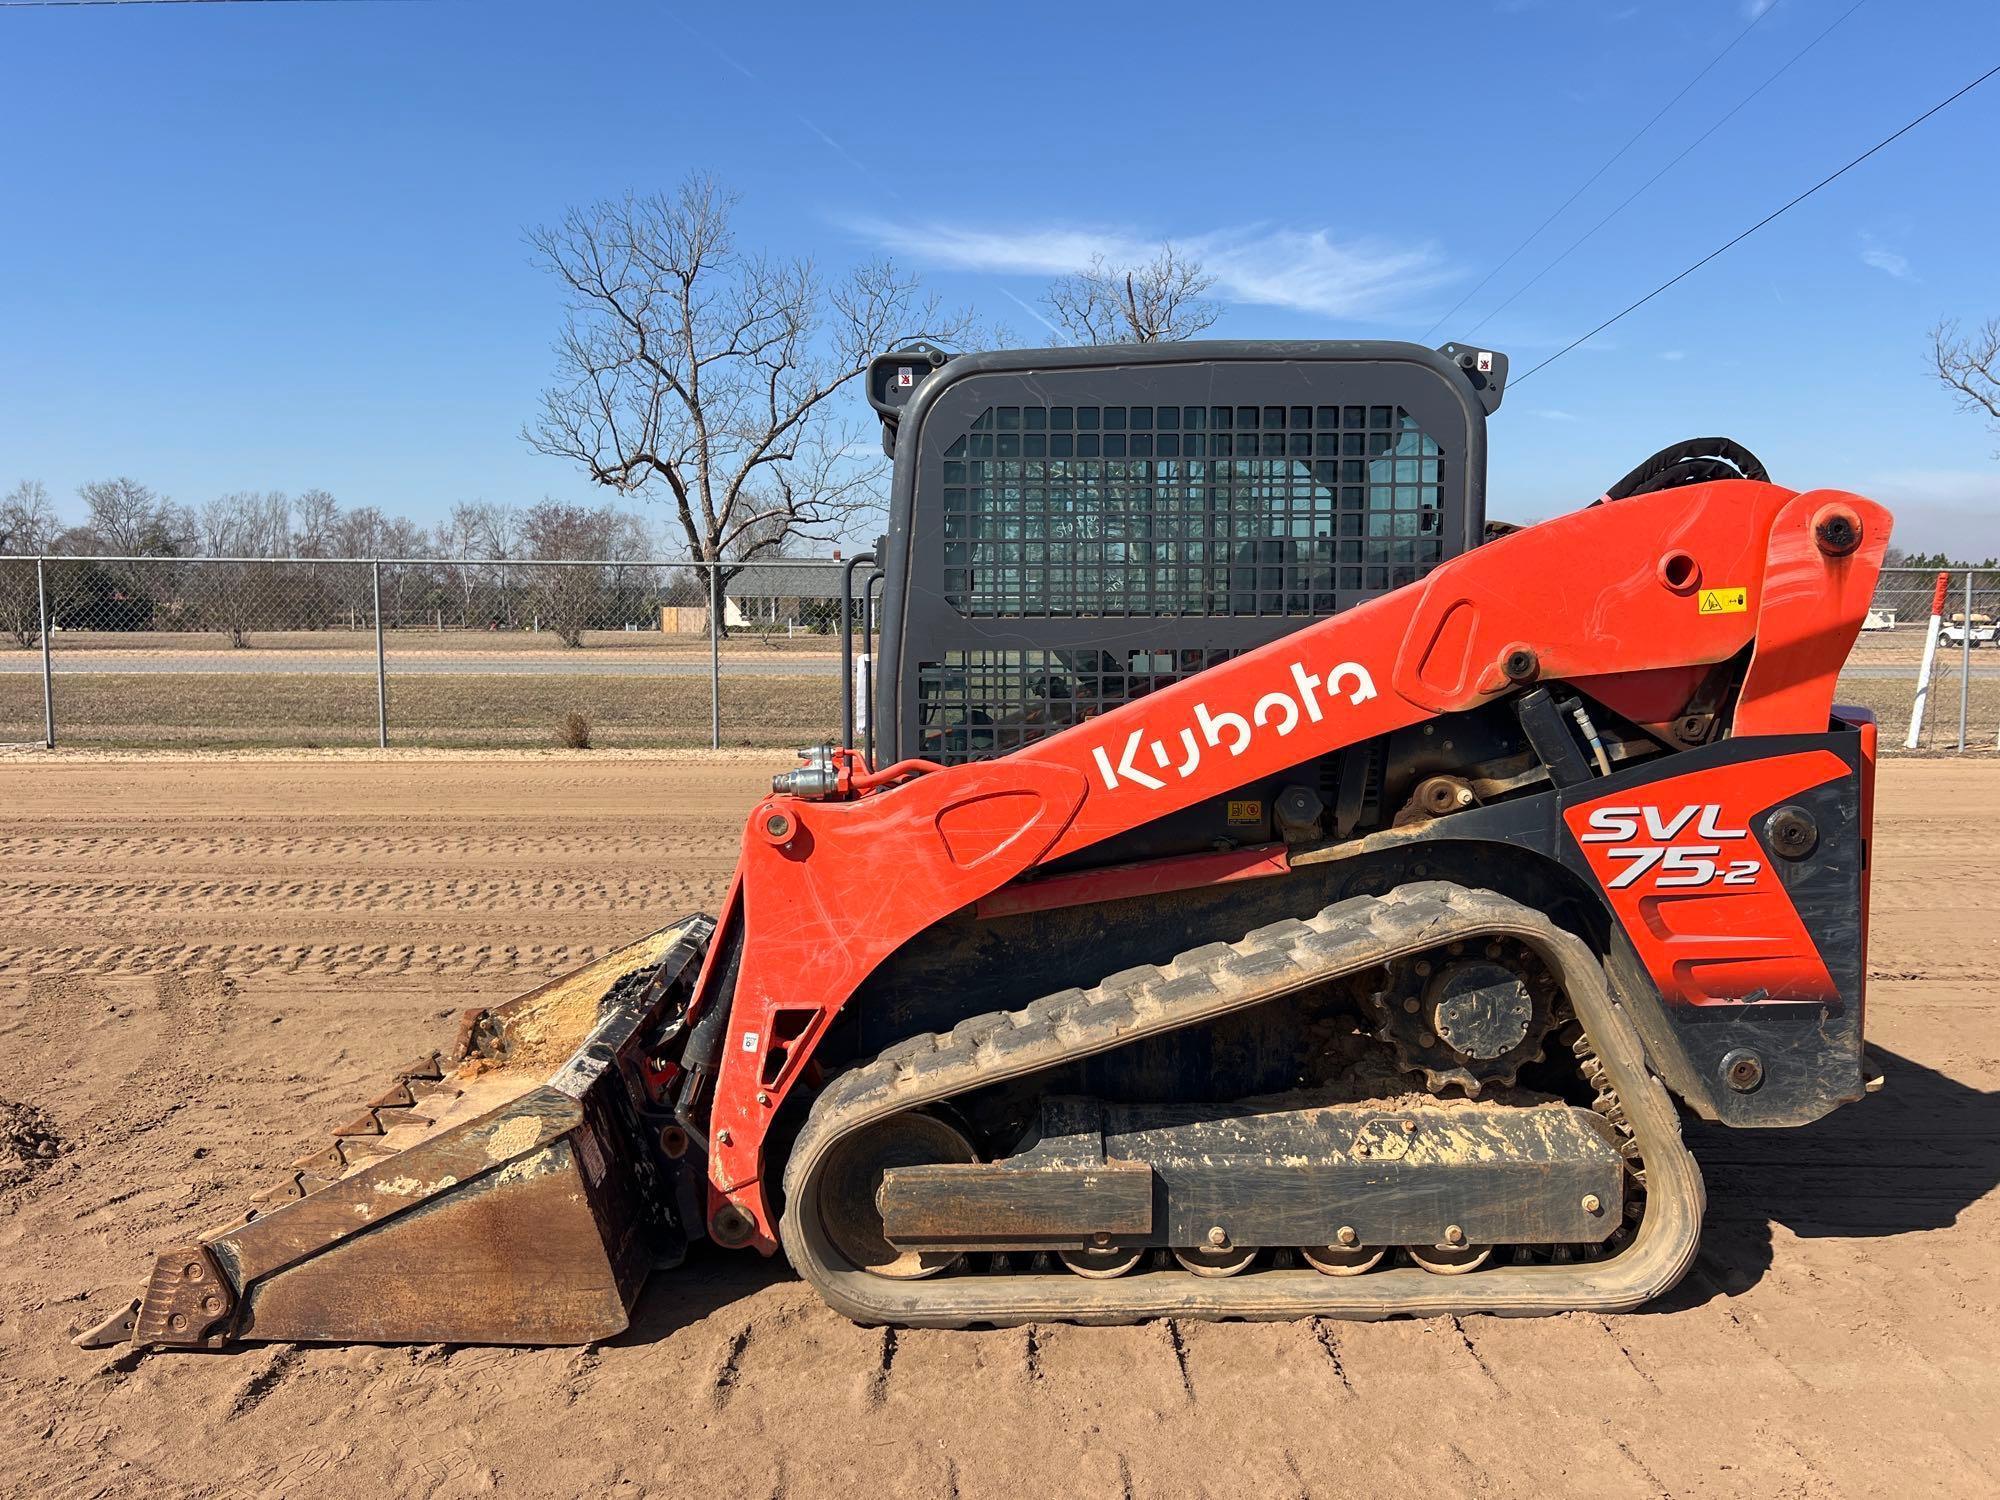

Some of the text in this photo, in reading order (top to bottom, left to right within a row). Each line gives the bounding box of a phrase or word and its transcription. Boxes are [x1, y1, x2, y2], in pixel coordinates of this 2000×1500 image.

[1092, 662, 1378, 790] Kubota
[1581, 804, 1747, 842] SVL
[1607, 845, 1761, 889] 75-2
